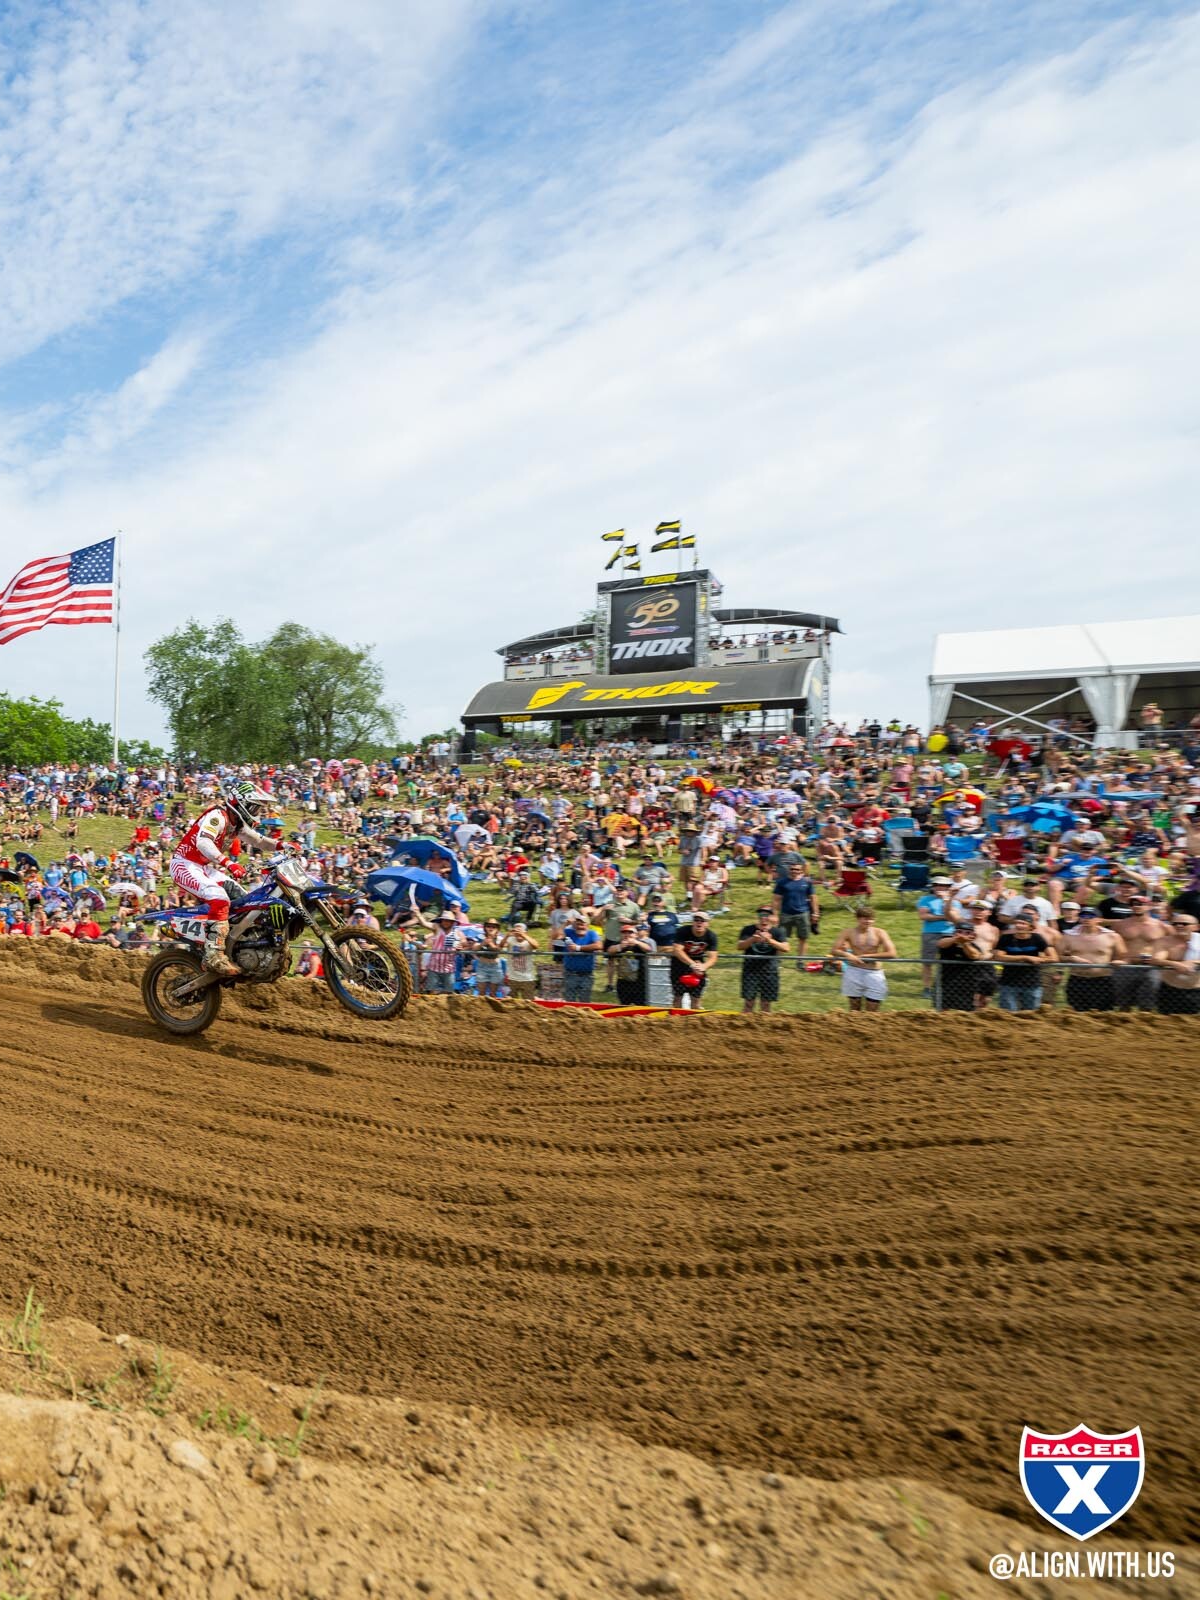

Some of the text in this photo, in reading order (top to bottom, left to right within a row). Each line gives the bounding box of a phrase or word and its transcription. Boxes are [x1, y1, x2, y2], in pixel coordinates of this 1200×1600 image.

[642, 574, 678, 585] THOR
[626, 598, 681, 628] 50
[611, 637, 694, 660] THOR
[580, 681, 720, 701] THOR
[721, 703, 762, 712] THOR
[180, 920, 202, 937] 14
